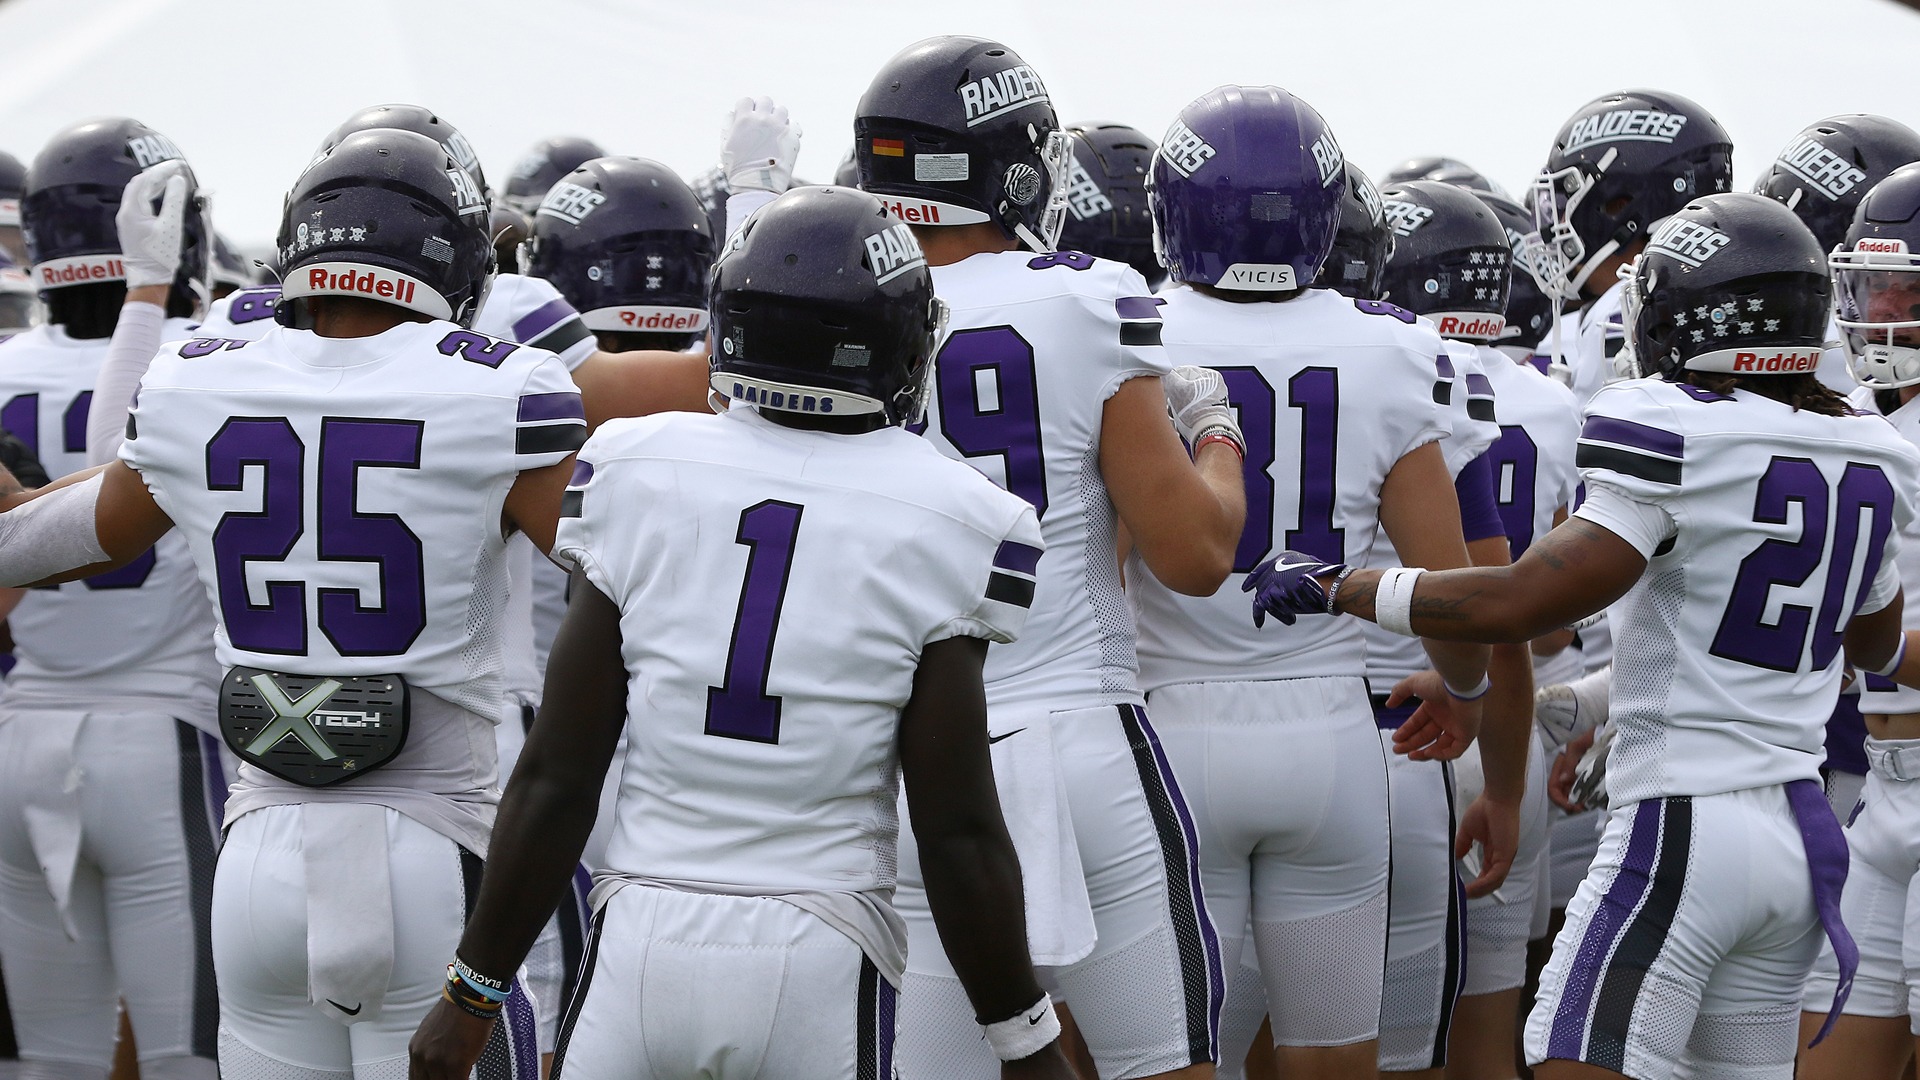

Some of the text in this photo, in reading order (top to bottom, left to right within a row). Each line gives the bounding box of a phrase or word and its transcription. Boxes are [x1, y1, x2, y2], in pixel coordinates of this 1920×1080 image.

[961, 65, 1048, 119] RAIDER
[1567, 110, 1687, 148] RAIDERS
[1163, 119, 1217, 173] DERS
[883, 200, 940, 223] dell
[1859, 241, 1900, 253] Riddell
[42, 260, 125, 284] Riddell
[309, 268, 416, 304] Riddell
[1232, 270, 1289, 283] VICIS
[619, 310, 700, 329] Riddell
[1440, 317, 1504, 336] Riddell
[1733, 352, 1819, 372] Riddell
[733, 382, 833, 413] RAIDERS
[906, 325, 1049, 521] 9
[205, 415, 427, 658] 25
[1708, 455, 1895, 673] 20
[704, 498, 805, 746] 1
[471, 972, 502, 989] BLACK
